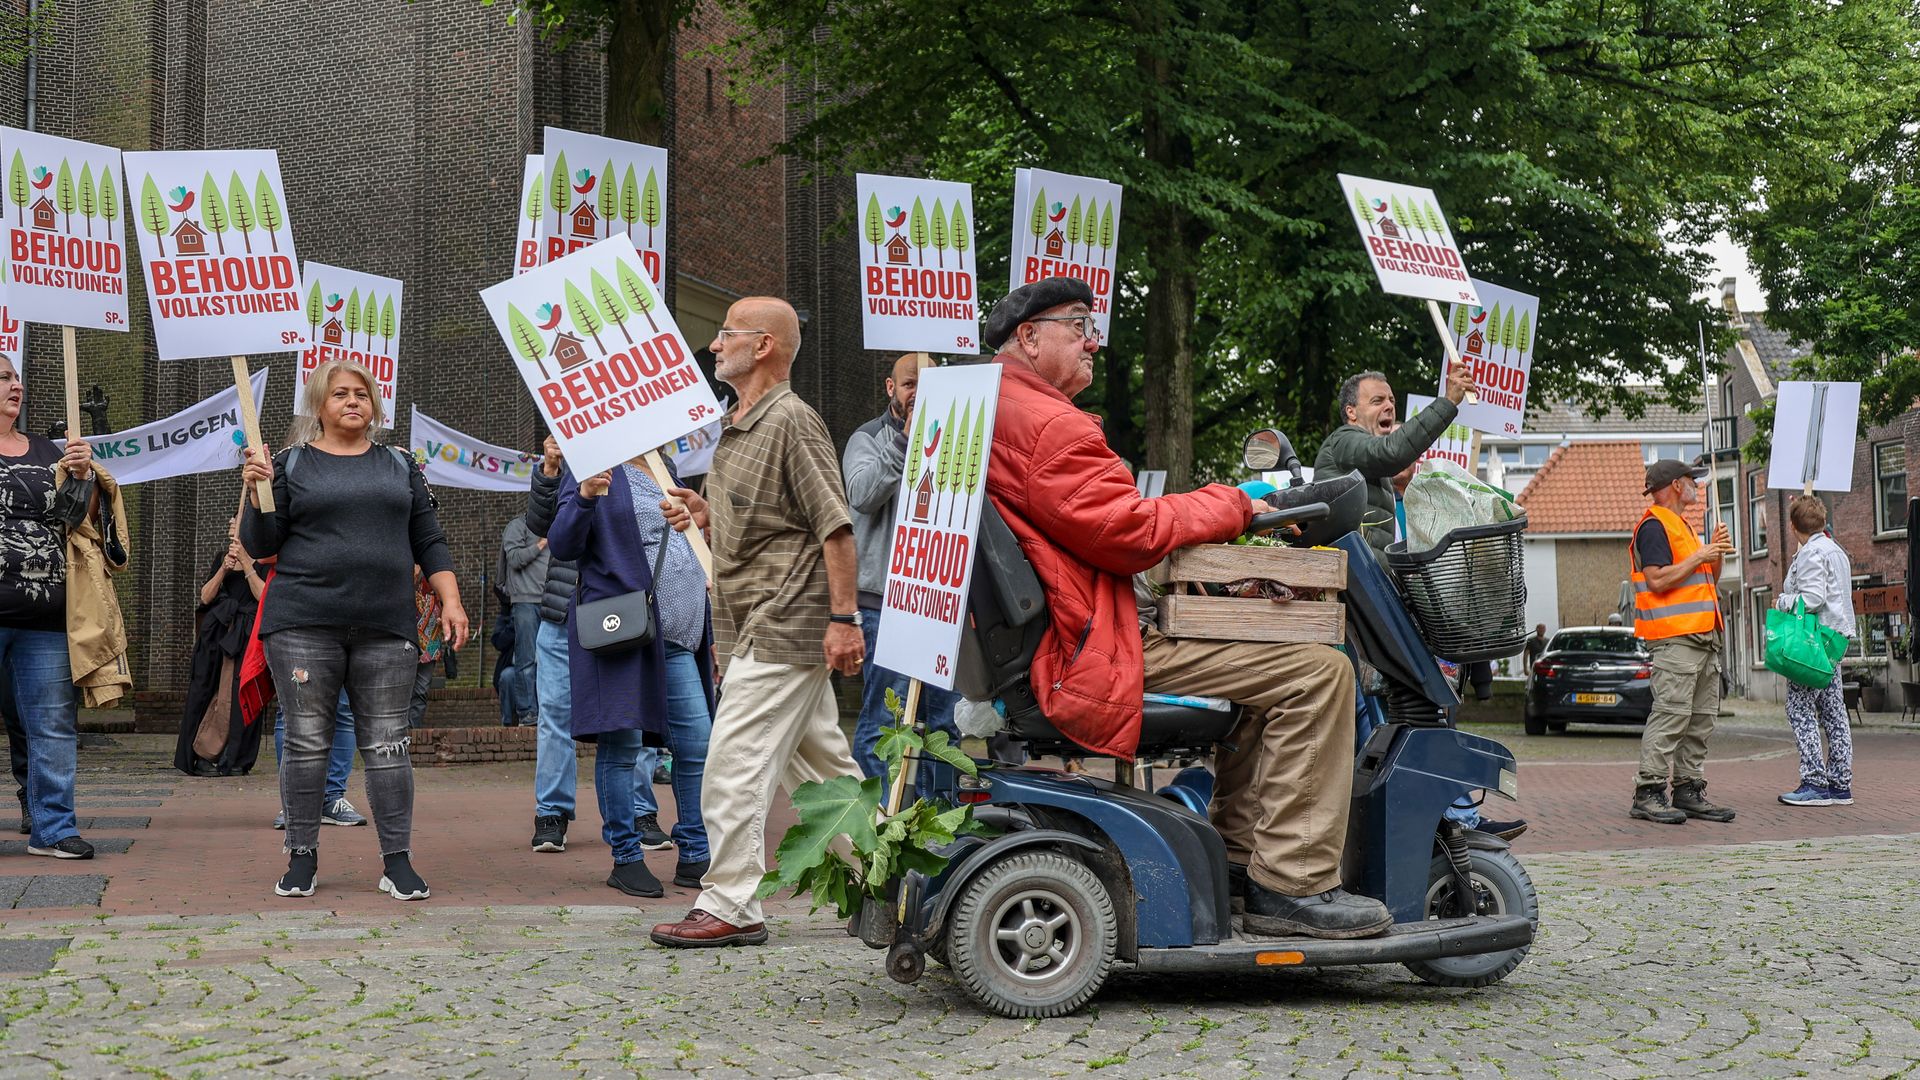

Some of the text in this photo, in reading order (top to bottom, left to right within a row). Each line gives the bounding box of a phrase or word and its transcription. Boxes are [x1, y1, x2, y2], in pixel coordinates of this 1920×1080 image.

[11, 228, 121, 274] BEHOUD
[1367, 235, 1461, 269] BEHOUD
[1376, 257, 1467, 282] VOLKSTUINEN
[12, 263, 122, 295] VOLKSTUINEN
[150, 255, 294, 296] BEHOUD
[866, 265, 972, 301] BEHOUD
[157, 291, 300, 319] VOLKSTUINEN
[868, 297, 973, 321] VOLKSTUINEN
[538, 332, 685, 420] BEHOUD
[556, 365, 699, 440] VOLKSTUINEN
[1474, 385, 1522, 411] STUINEN
[91, 408, 238, 460] NKS LIGGEN
[427, 440, 532, 478] VOLKSTU
[891, 525, 969, 589] BEHOUD
[886, 578, 961, 625] VOLKSTUINEN
[604, 617, 619, 629] MK
